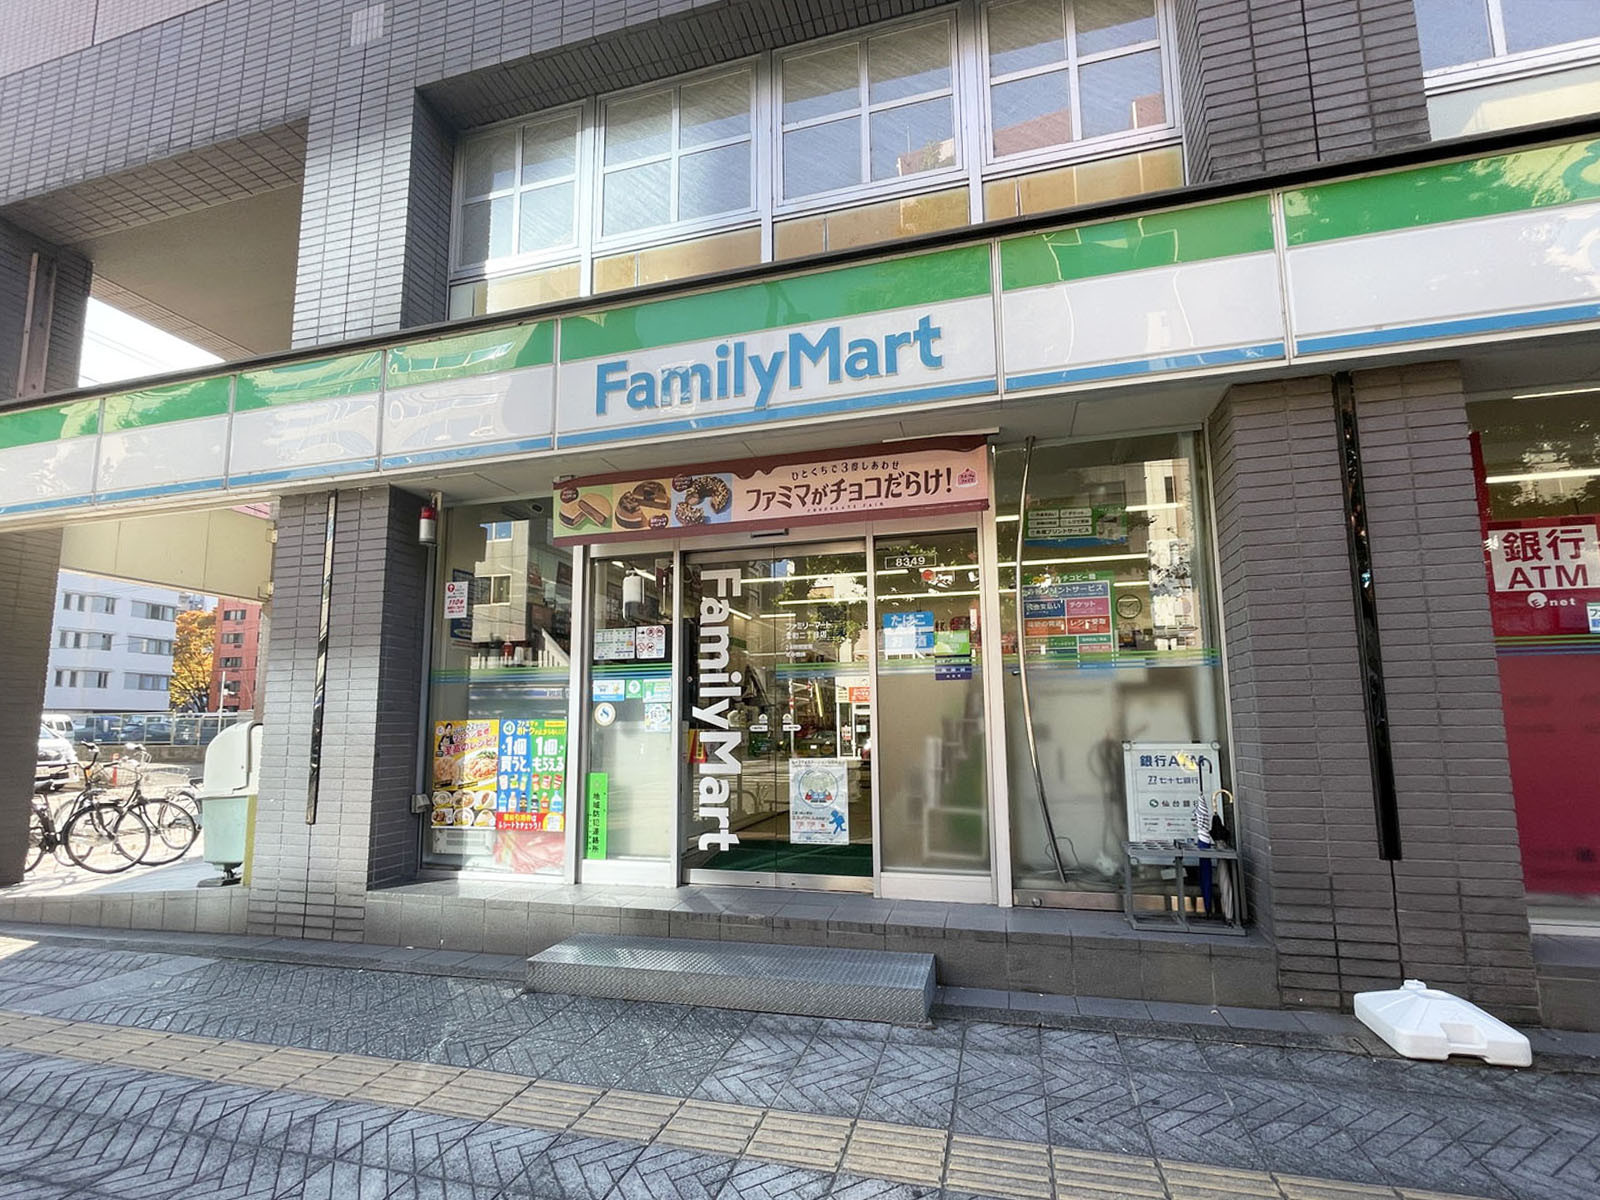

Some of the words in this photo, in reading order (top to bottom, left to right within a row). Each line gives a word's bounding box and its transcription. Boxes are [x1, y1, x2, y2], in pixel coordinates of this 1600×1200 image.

[596, 314, 944, 416] FamilyMart
[791, 460, 900, 481] ひとくちで3度しあわせ
[746, 467, 952, 512] ファミマがチョコだらけ!
[895, 556, 926, 567] 8349
[1501, 528, 1585, 563] 銀行
[1508, 564, 1589, 590] ATM
[692, 568, 742, 851] FamilyMart
